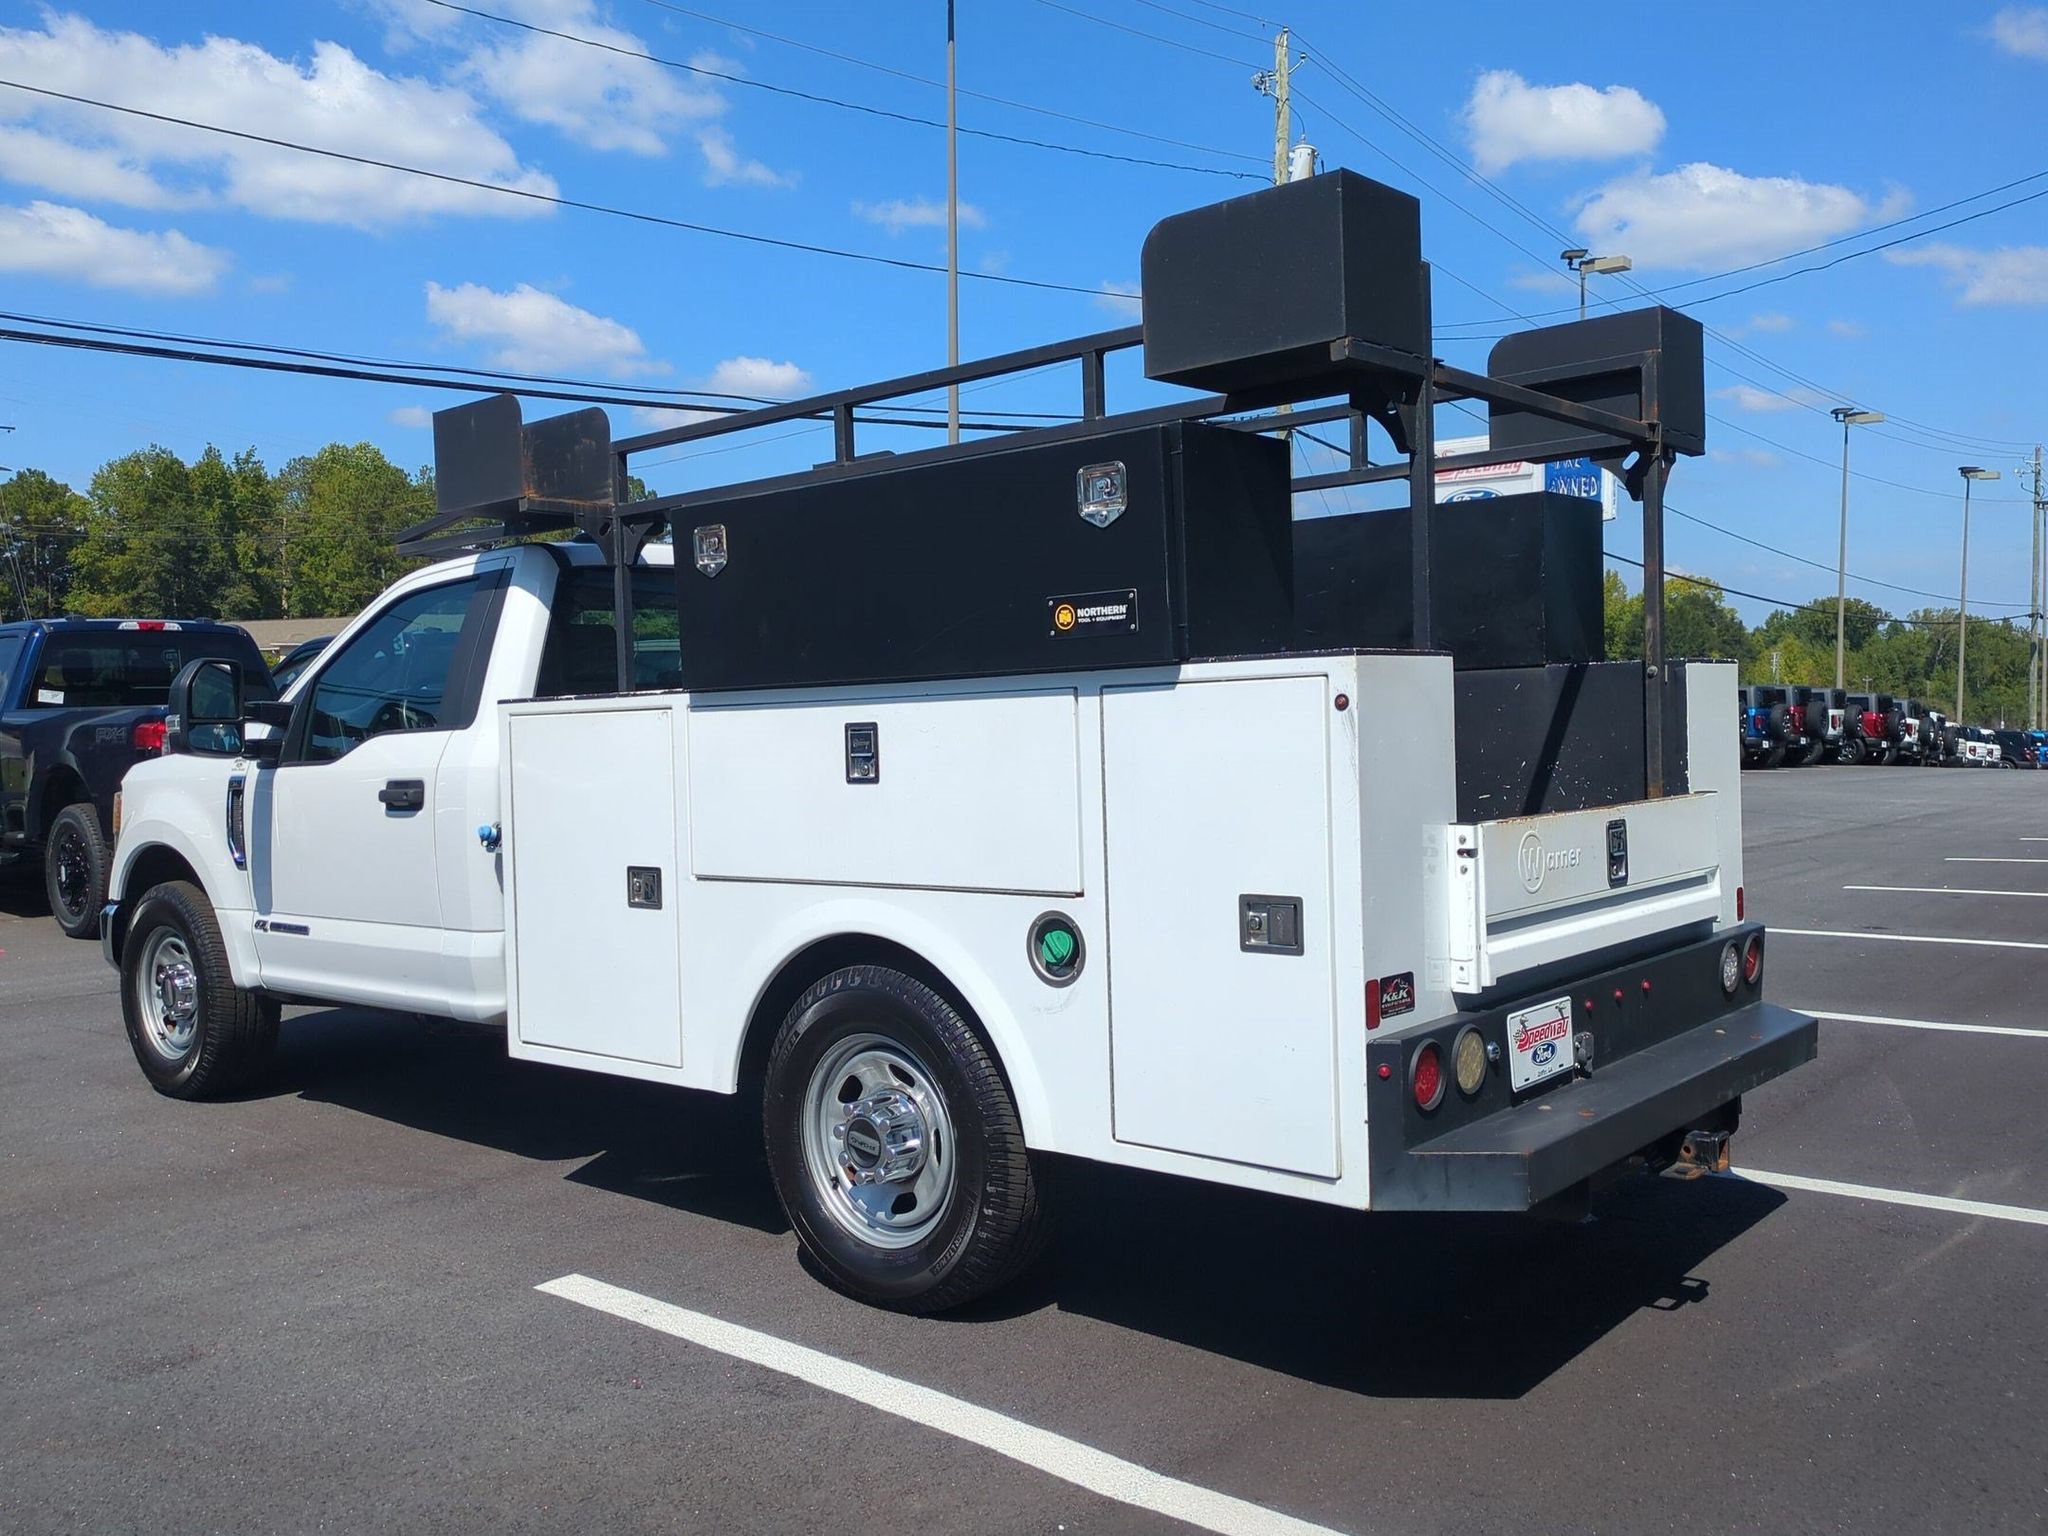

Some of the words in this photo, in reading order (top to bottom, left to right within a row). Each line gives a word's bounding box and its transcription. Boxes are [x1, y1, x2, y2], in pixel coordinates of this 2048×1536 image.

[1077, 605, 1127, 617] NORTHERN
[1096, 614, 1127, 622] EQUIPMENT
[96, 727, 126, 743] FX4
[1520, 845, 1581, 884] Warner
[1381, 988, 1409, 1004] K&K
[1517, 1019, 1569, 1052] Speedway
[1534, 1044, 1554, 1063] Ford
